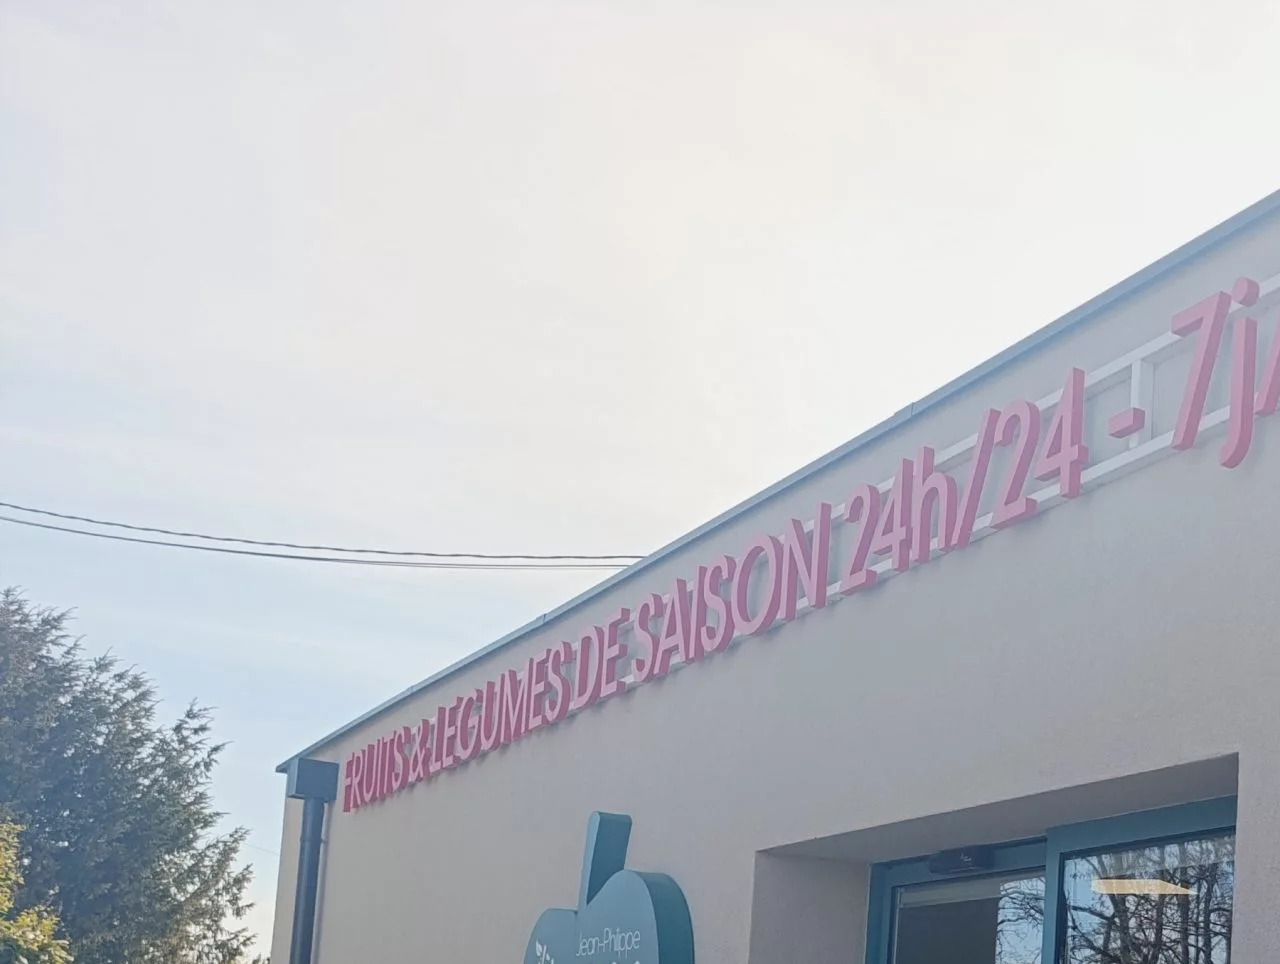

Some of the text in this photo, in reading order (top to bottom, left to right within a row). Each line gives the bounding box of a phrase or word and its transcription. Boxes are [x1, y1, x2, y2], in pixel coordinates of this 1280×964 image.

[342, 725, 412, 813] FRUITS
[408, 717, 431, 783] &
[429, 640, 573, 773] LEGUMES
[568, 607, 631, 711] DE
[631, 501, 832, 683] SAISON
[840, 367, 1089, 596] 24h/24
[575, 926, 641, 959] Jean-Philippe
